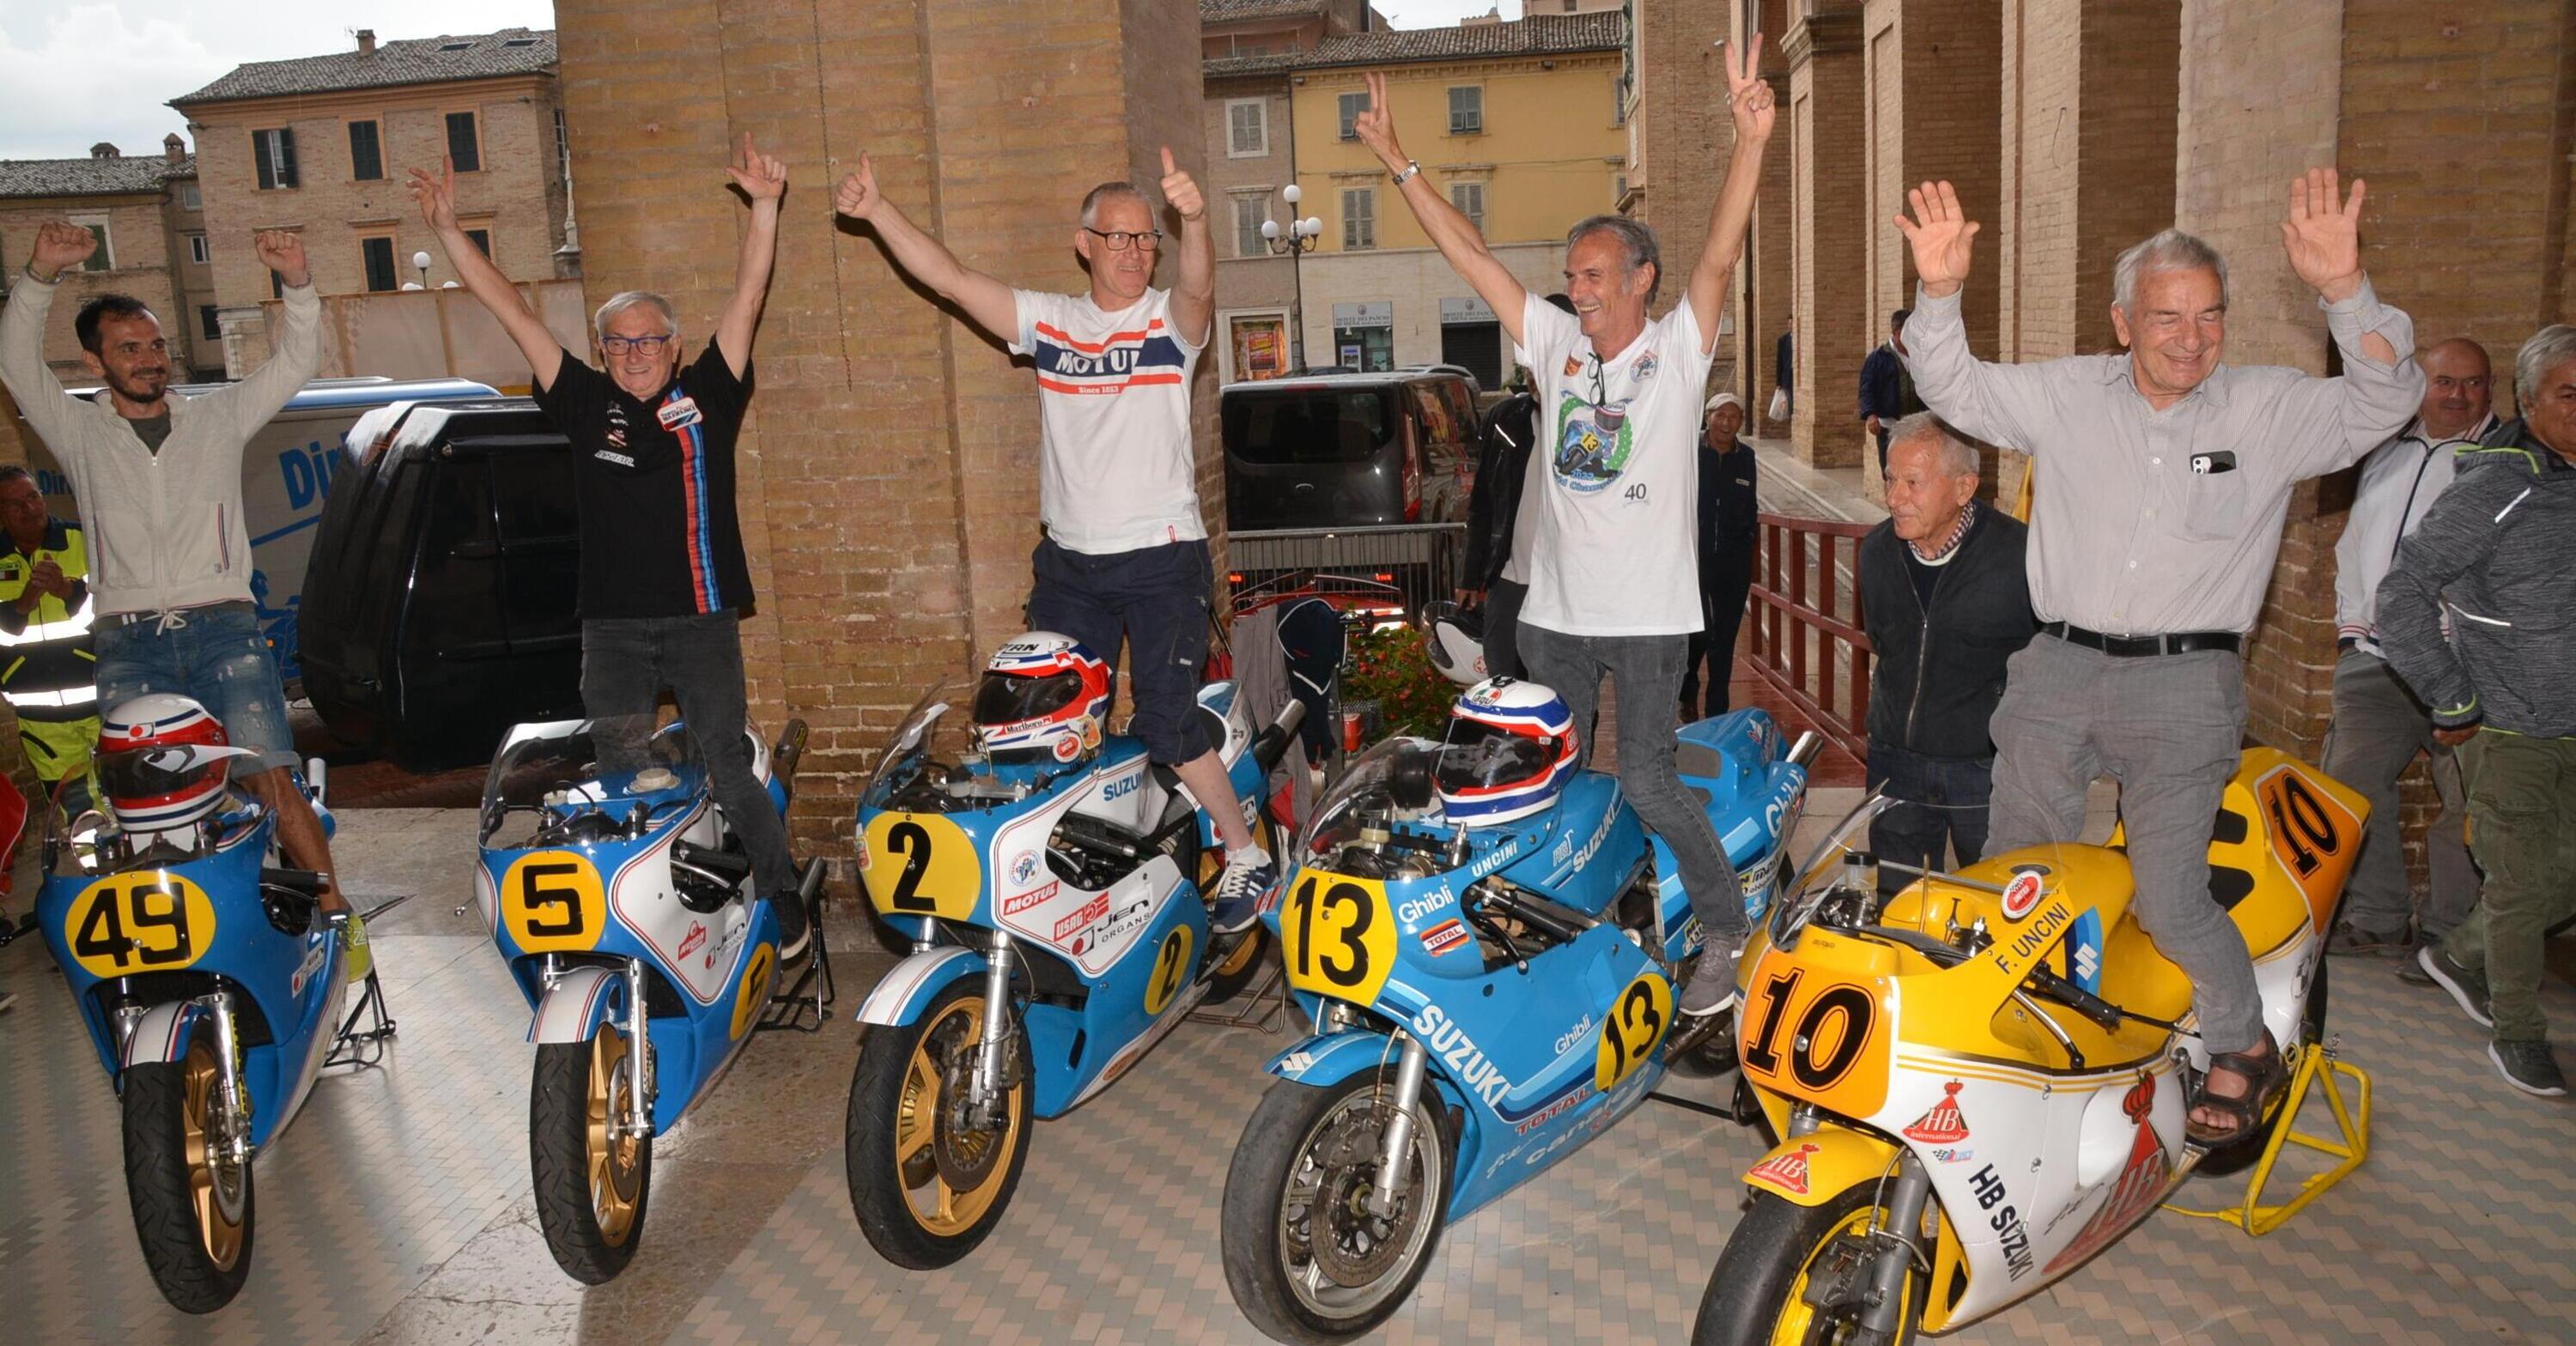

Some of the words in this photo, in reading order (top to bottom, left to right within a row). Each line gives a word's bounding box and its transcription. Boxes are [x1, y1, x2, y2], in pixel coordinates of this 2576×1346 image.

[1102, 385, 1119, 394] 1853
[1583, 434, 1599, 451] 13
[1625, 482, 1647, 500] 40
[1006, 719, 1043, 734] Marlboro
[1573, 800, 1617, 872] SUZUKI
[2269, 773, 2340, 880] 10
[887, 822, 936, 912] 2
[1471, 841, 1518, 877] UNCINI
[522, 863, 584, 937] 5
[1009, 883, 1057, 914] MOTUL
[1398, 883, 1455, 924] Ghibli
[75, 882, 191, 967] 49
[1102, 912, 1151, 943] ORGANS
[1293, 876, 1375, 987] 13
[1429, 930, 1461, 946] TOTAL
[1995, 954, 2018, 975] F.
[2011, 901, 2070, 958] UNCINI
[1157, 931, 1182, 1006] 2
[1554, 1013, 1591, 1054] Ghibli
[1603, 979, 1661, 1083] 13
[1744, 967, 1876, 1092] 10
[1413, 1004, 1512, 1109] SUZUKI
[1515, 1088, 1589, 1136] TOTAL
[1921, 1108, 1960, 1132] HB
[1910, 1131, 1962, 1141] international
[1767, 1155, 1803, 1179] HB
[1968, 1162, 2006, 1210] HB
[1990, 1205, 2034, 1282] SUZUKI
